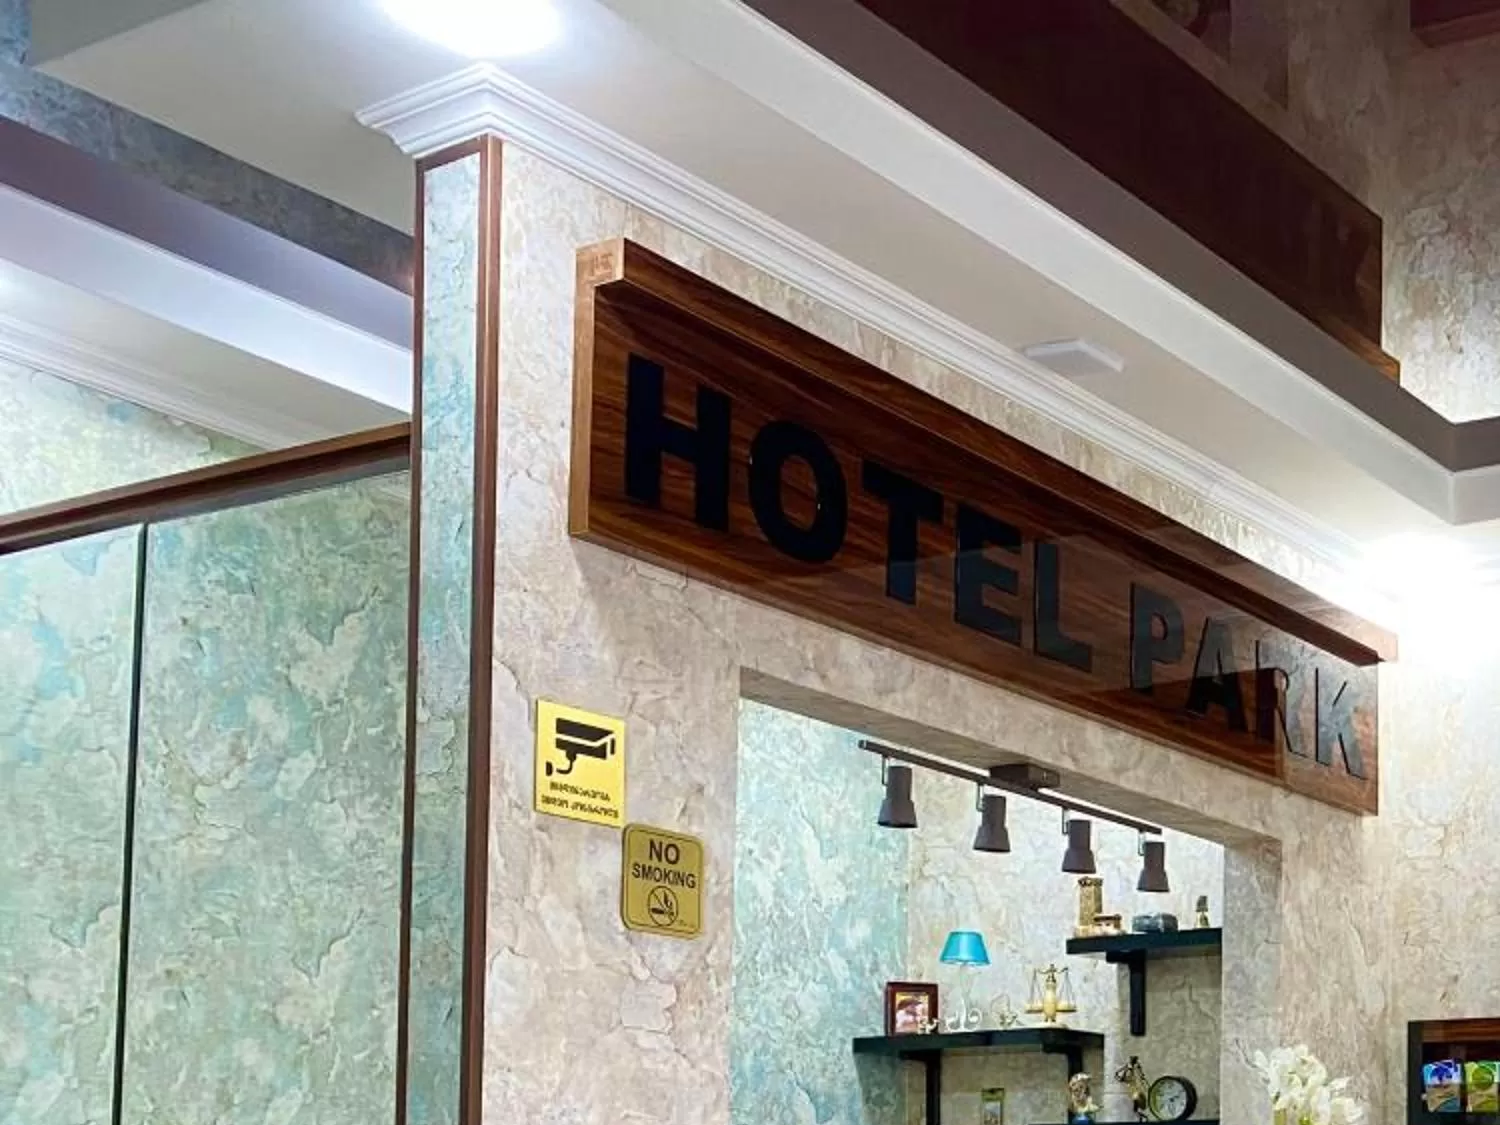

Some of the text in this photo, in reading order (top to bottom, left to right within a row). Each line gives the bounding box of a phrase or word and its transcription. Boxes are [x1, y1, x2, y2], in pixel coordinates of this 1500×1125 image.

[624, 352, 1369, 779] HOTEL PARK
[649, 839, 680, 865] NO
[632, 863, 696, 888] SMOKING
